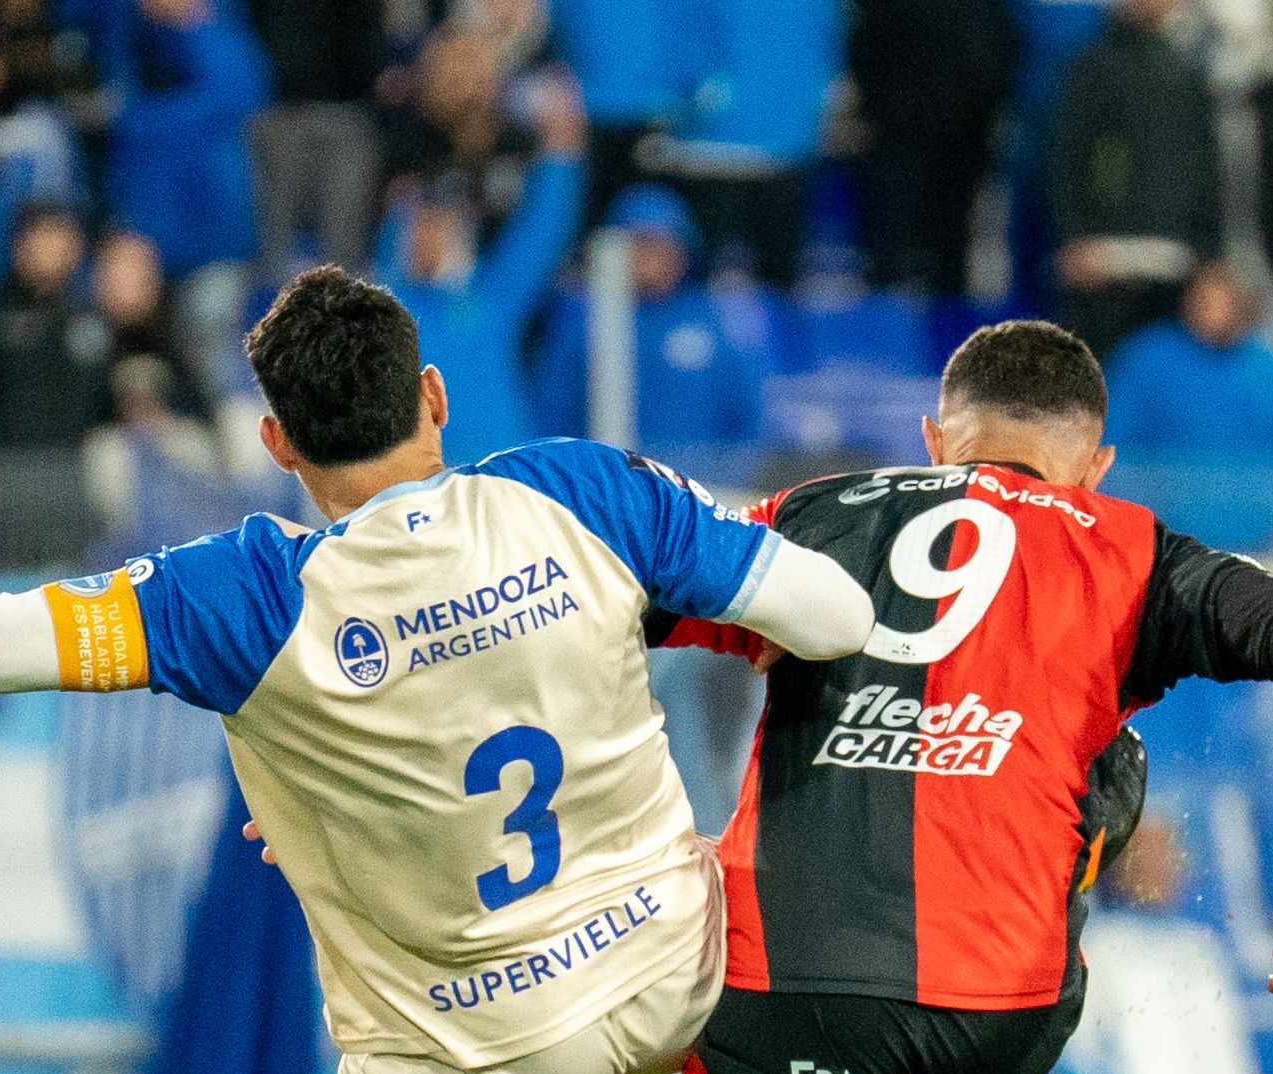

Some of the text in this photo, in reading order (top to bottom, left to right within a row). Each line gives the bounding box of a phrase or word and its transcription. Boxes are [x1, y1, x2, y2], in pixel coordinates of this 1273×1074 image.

[107, 601, 120, 622] TU
[394, 556, 569, 641] MENDOZA
[863, 498, 1016, 664] 9
[72, 604, 88, 625] ES
[89, 603, 111, 669] HABLAR
[111, 624, 129, 663] VIDA
[408, 591, 580, 673] ARGENTINA
[838, 684, 1024, 741] flecha
[826, 732, 995, 770] CARGA
[464, 725, 564, 912] 3
[429, 886, 662, 1013] SUPERVIELLE
